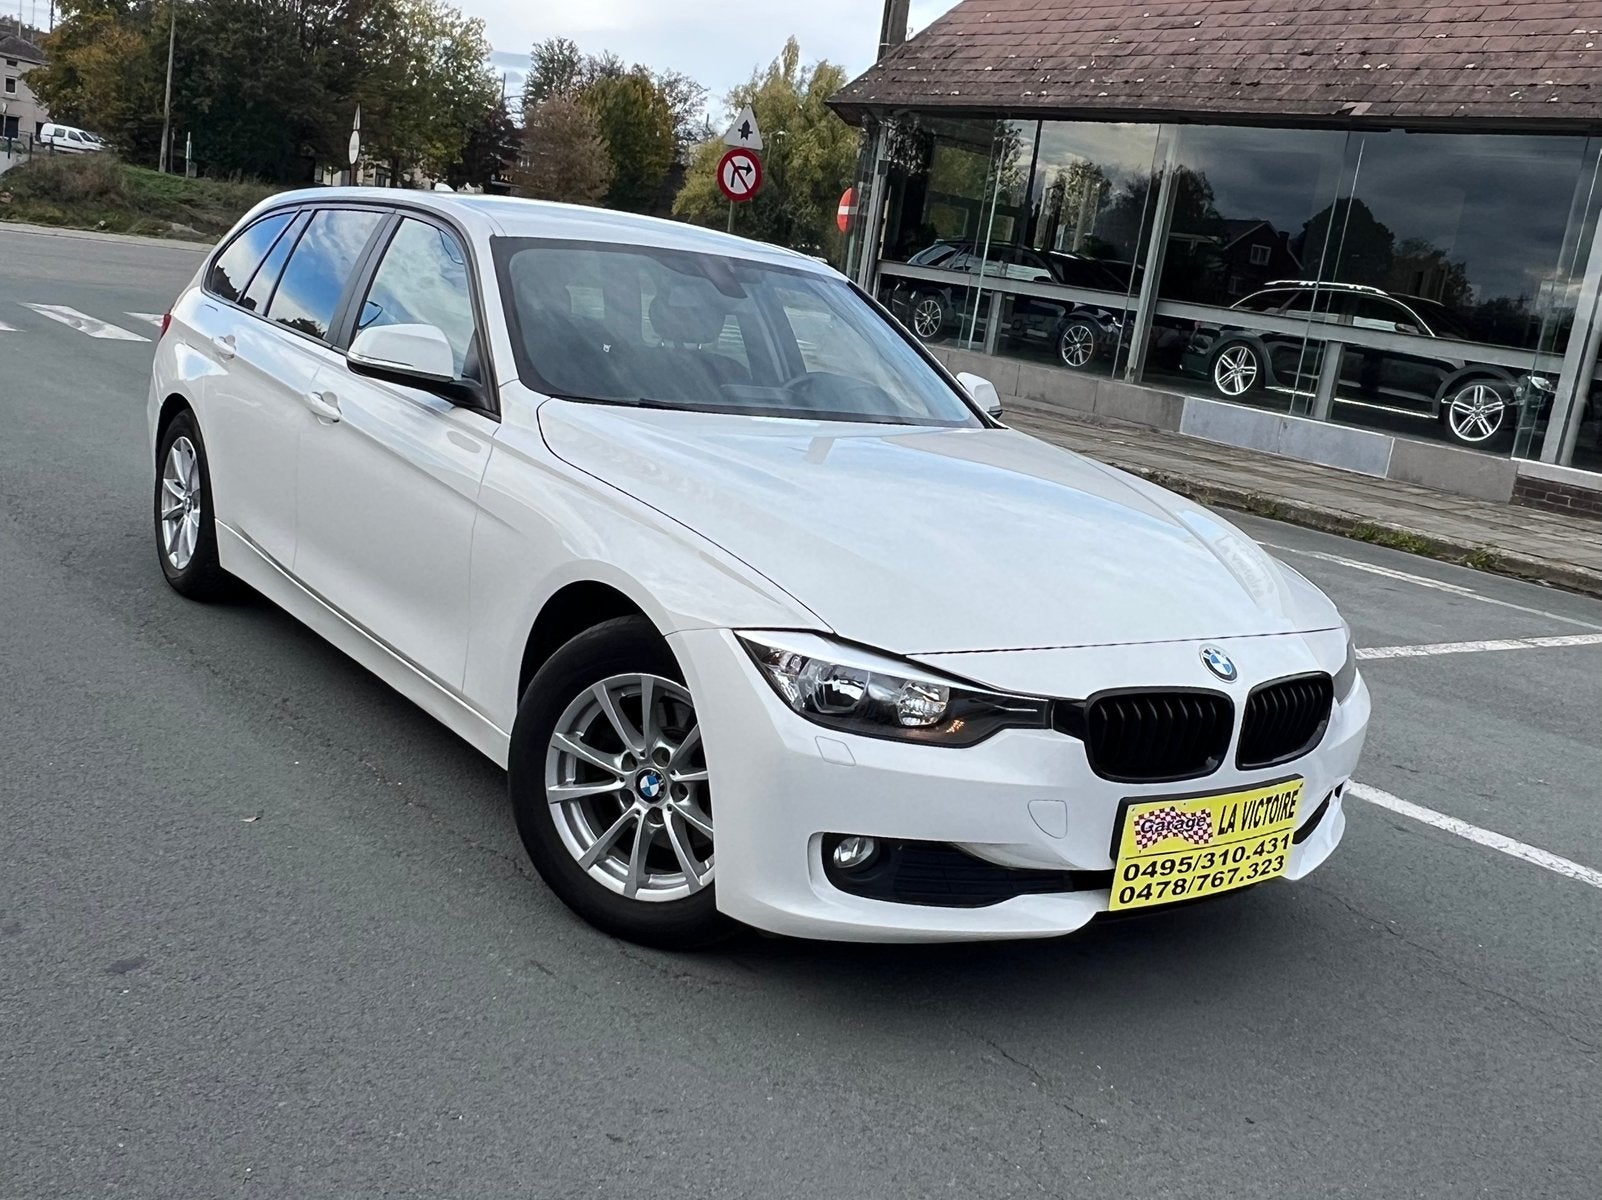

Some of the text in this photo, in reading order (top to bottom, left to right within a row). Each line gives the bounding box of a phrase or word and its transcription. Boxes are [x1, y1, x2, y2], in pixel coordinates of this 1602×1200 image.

[1140, 789, 1299, 836] Garage LA VICTOIRE
[1119, 855, 1284, 904] 0478/767.323
[1123, 833, 1290, 882] 0495/310.431
